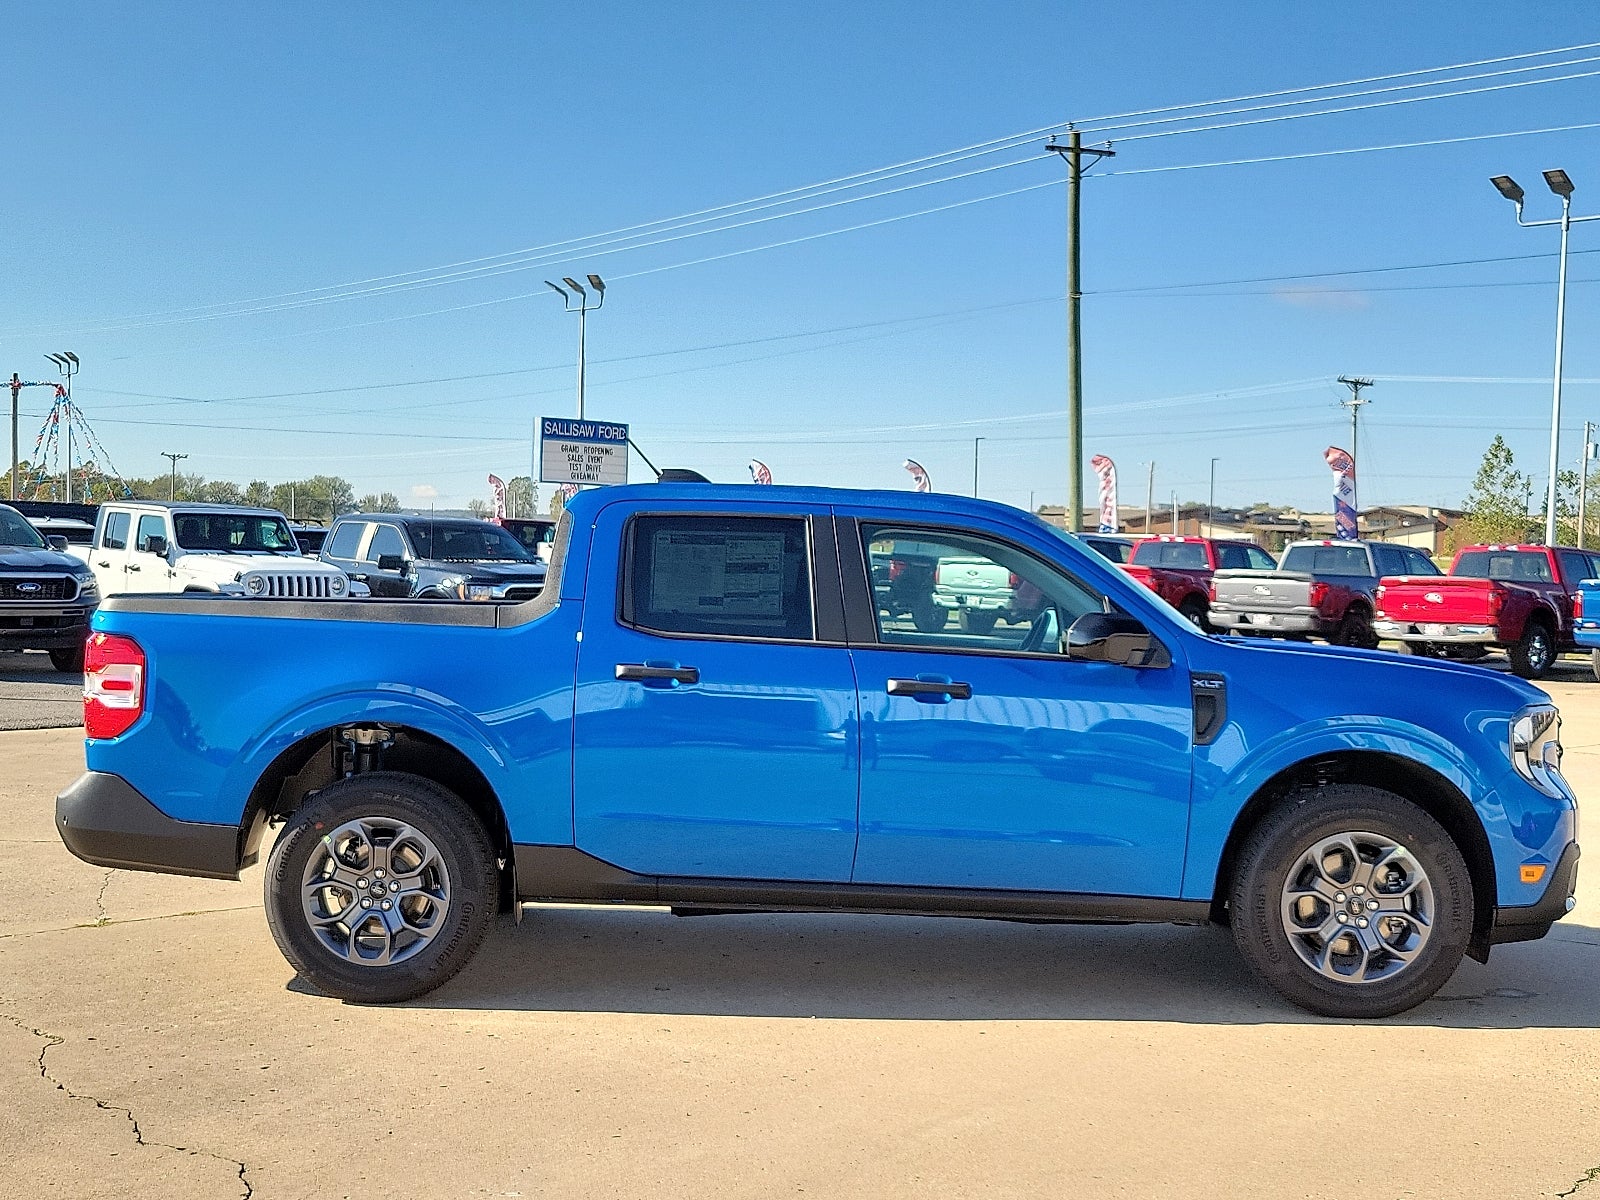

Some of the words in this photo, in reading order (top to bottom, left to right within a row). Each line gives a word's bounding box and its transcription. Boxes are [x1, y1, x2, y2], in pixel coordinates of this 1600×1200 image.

[544, 421, 596, 438] SALLISAW
[598, 425, 626, 440] FORD
[560, 444, 580, 454] GRAND
[583, 446, 614, 456] REOPENING
[567, 454, 584, 463] SALES
[587, 456, 604, 464] EVENT
[569, 463, 583, 471] TEST
[585, 464, 602, 473] DRIVE
[570, 472, 600, 481] GIVEAWAY
[1192, 679, 1225, 689] XLT
